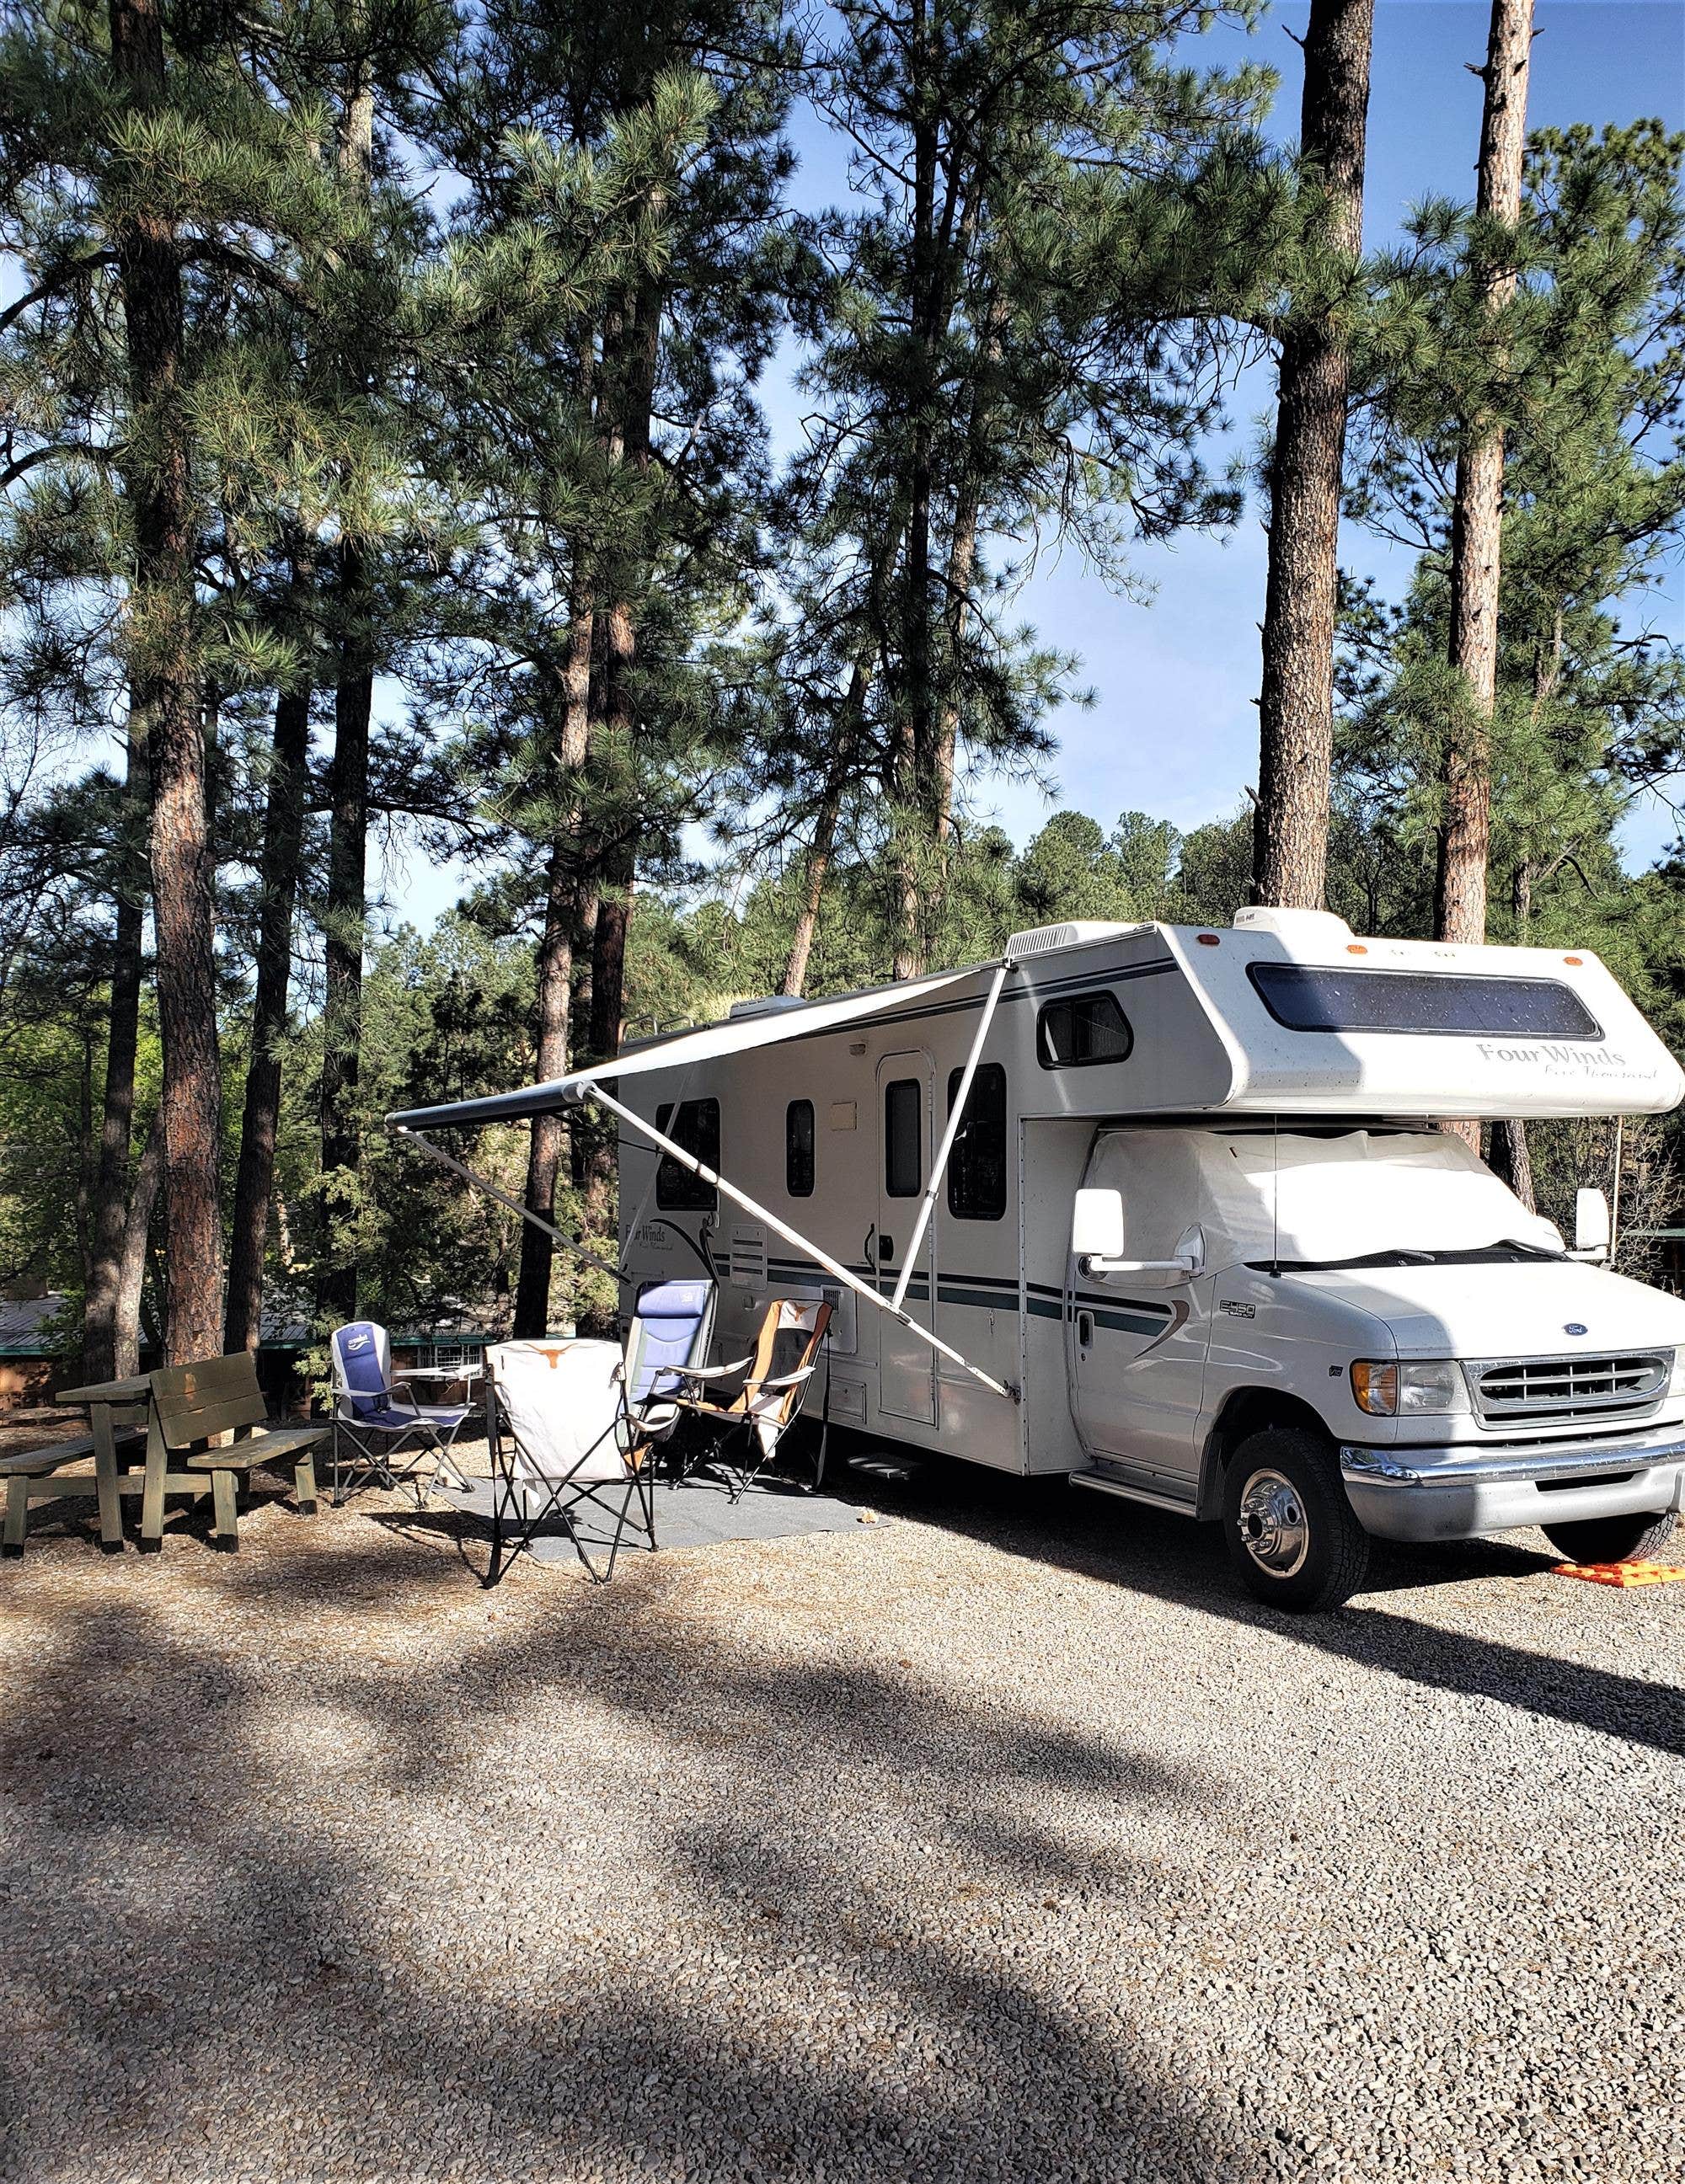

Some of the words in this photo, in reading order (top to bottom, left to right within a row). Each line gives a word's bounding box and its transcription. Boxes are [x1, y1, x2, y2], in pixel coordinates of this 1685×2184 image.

[1476, 1044, 1540, 1063] Four
[1541, 1045, 1628, 1066] Winds
[642, 1225, 666, 1242] Winds
[1221, 1300, 1255, 1315] E450
